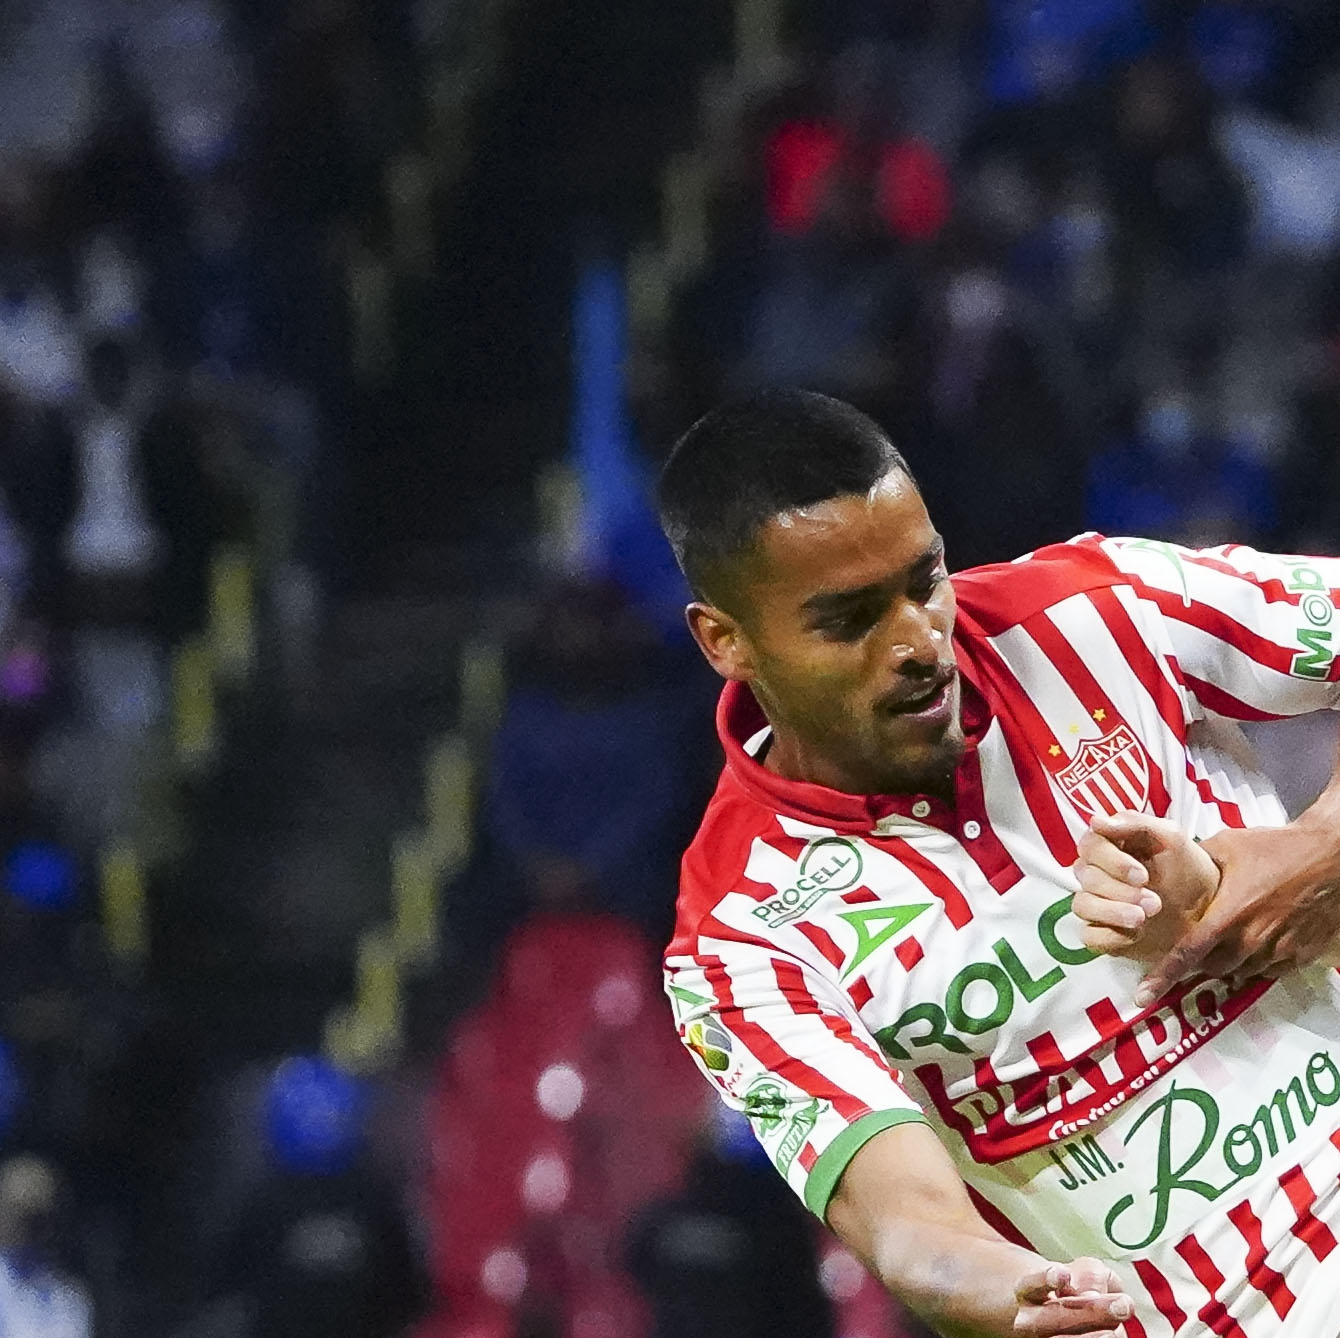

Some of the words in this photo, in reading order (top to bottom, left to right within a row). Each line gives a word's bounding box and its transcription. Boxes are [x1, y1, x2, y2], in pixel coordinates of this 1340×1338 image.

[1063, 735, 1132, 788] NECAXA
[751, 856, 852, 921] PROCELL
[952, 977, 1236, 1136] PLAYDO
